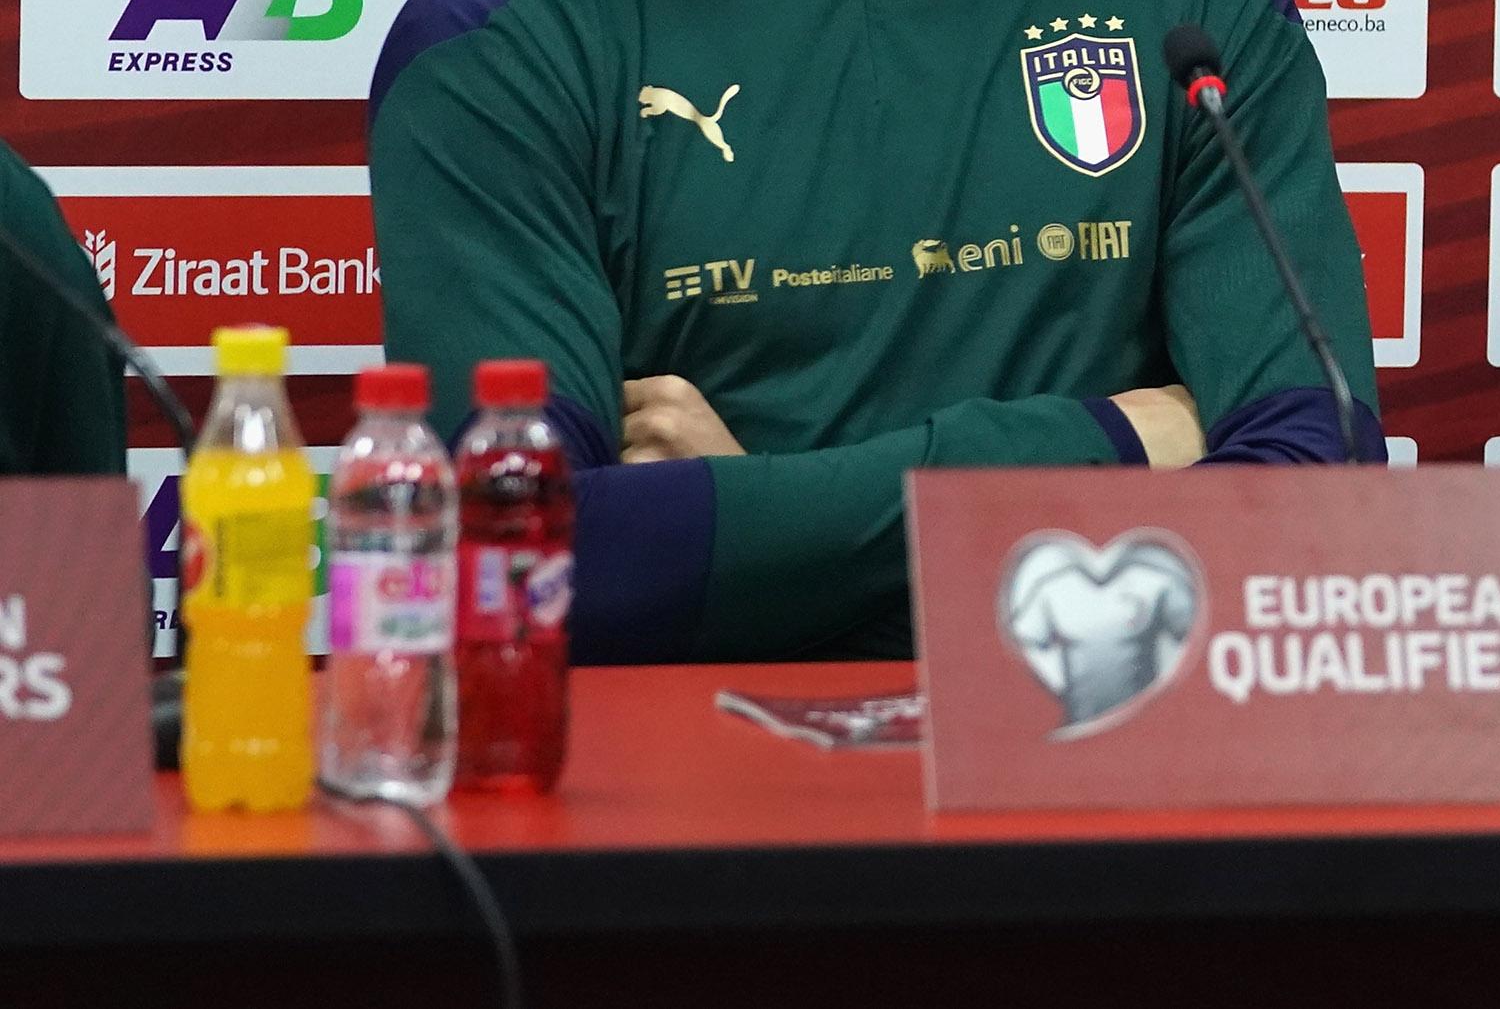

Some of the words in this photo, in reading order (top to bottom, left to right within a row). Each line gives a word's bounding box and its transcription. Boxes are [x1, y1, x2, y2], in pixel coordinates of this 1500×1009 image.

[1301, 14, 1385, 33] eneco.ba
[109, 52, 232, 72] EXPRESS
[1034, 48, 1125, 72] ITALIA
[958, 223, 1024, 272] eni
[1078, 220, 1132, 261] FIAT
[132, 248, 269, 295] Ziraat
[704, 258, 755, 291] TV
[772, 264, 894, 288] Posteitaliane
